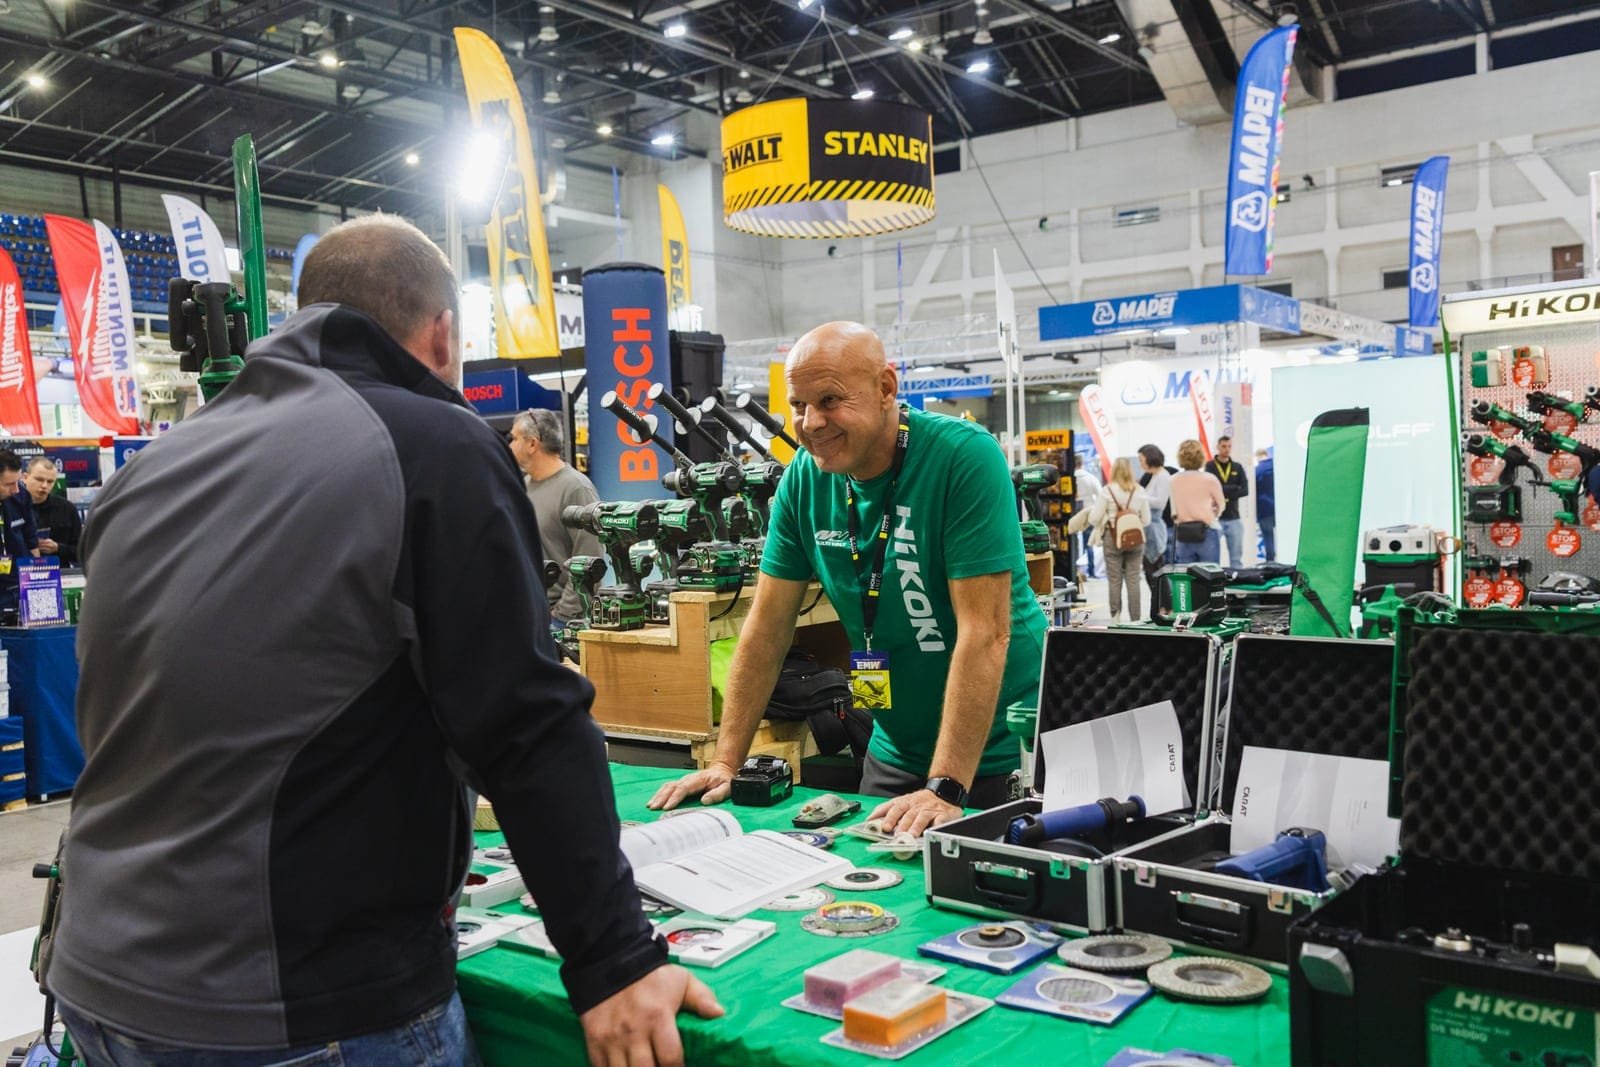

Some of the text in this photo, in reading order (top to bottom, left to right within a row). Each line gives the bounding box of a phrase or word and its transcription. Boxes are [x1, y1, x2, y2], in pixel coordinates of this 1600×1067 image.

[824, 131, 929, 164] STANLEY
[1238, 86, 1275, 186] MAPEI
[722, 136, 782, 175] EWALT
[1413, 184, 1437, 260] MAPEI
[1118, 297, 1176, 323] MAPEI
[1489, 292, 1600, 321] HiKO
[463, 384, 503, 400] BOSCH
[612, 307, 659, 482] BOSCH
[1494, 527, 1517, 535] STOP
[1552, 534, 1576, 543] STOP
[894, 505, 946, 652] HiKOKI
[1468, 584, 1490, 592] STOP
[1497, 585, 1519, 593] STOP
[856, 661, 880, 670] EMW
[1454, 991, 1575, 1031] HiKOKI
